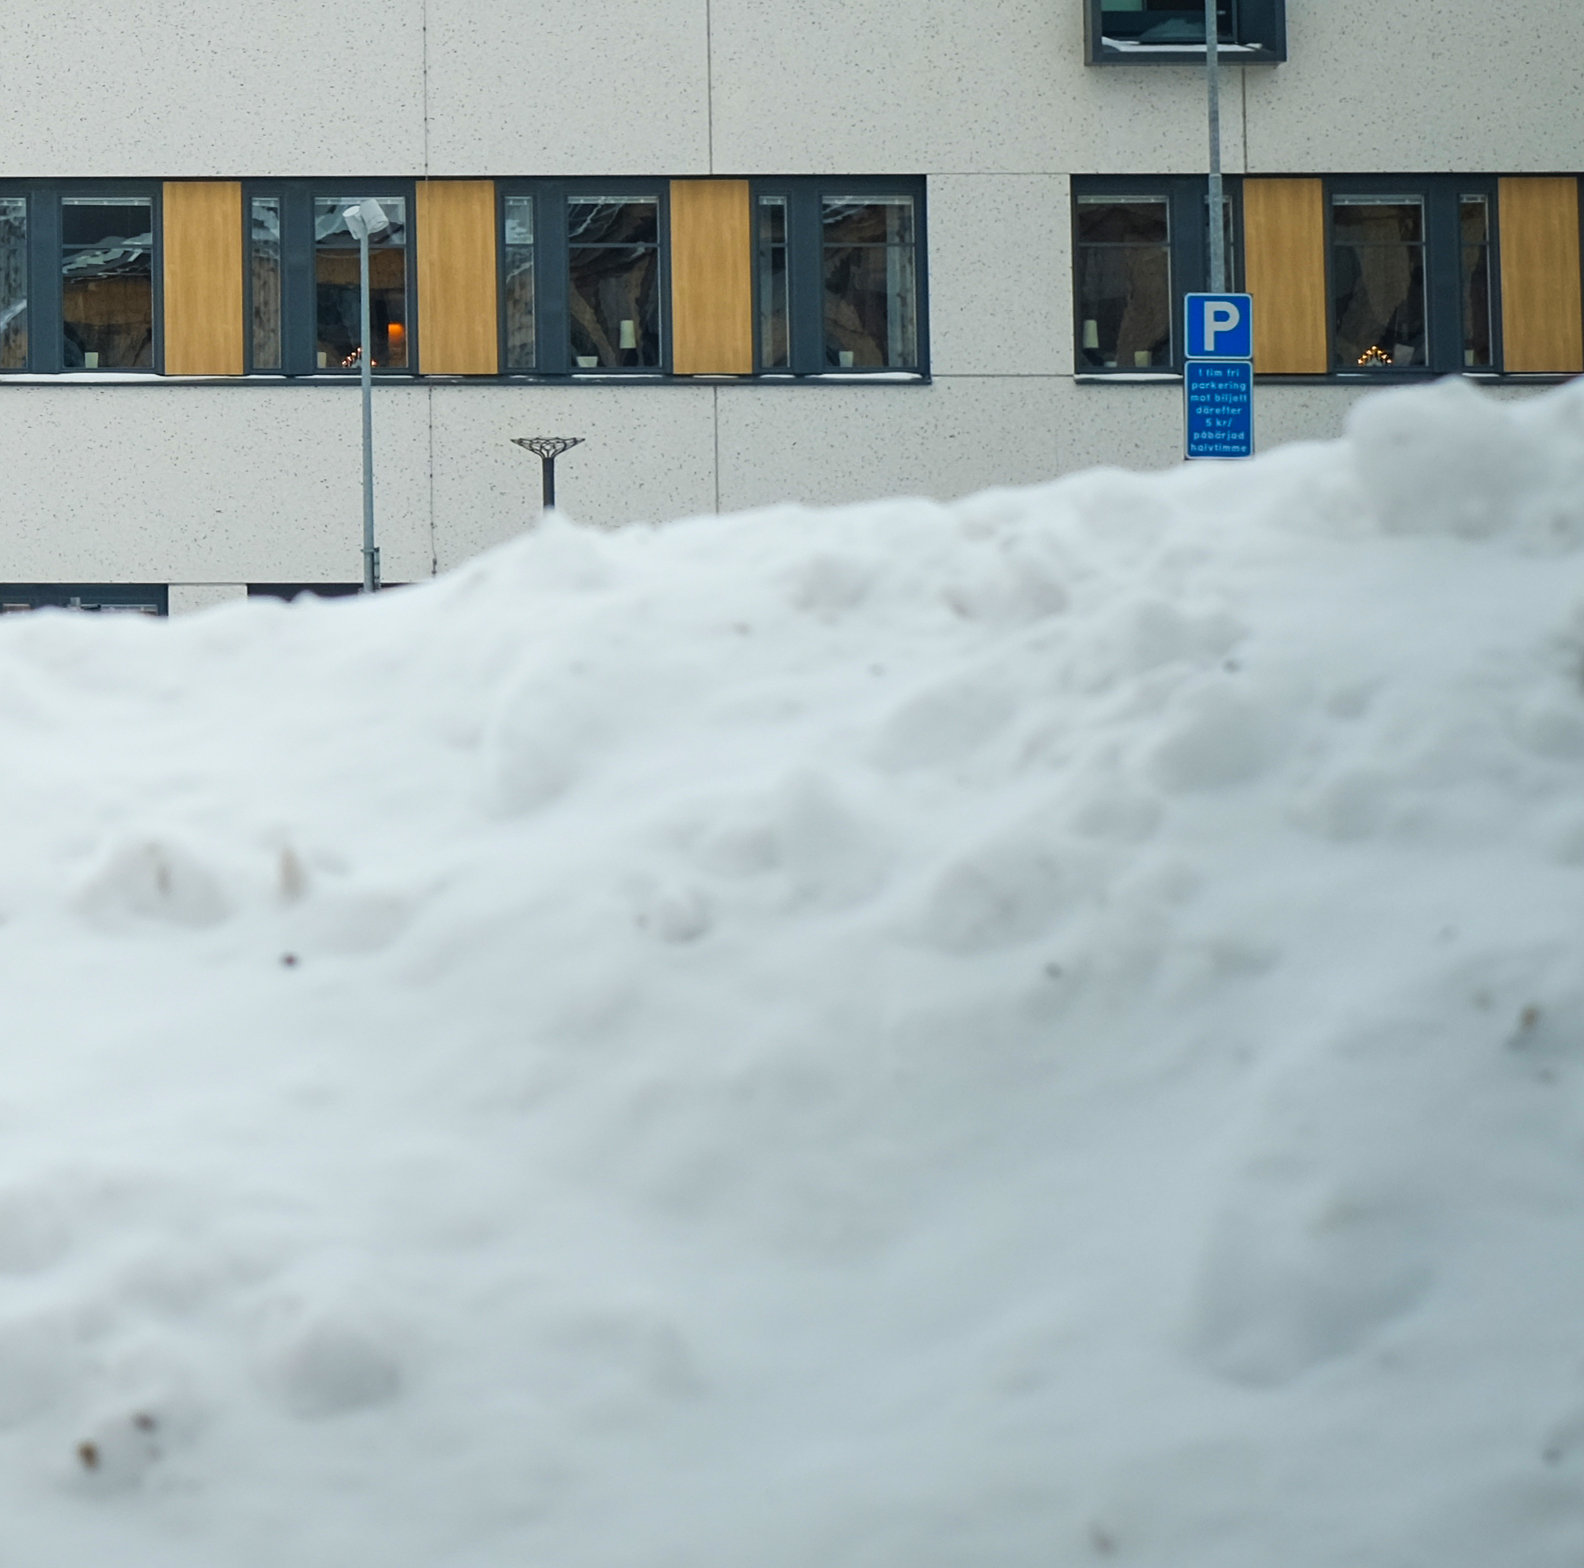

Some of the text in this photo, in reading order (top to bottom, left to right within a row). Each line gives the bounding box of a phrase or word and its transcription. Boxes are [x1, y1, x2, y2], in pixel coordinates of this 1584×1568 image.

[1204, 301, 1240, 351] P
[1206, 368, 1223, 377] tim
[1227, 368, 1240, 377] fri
[1191, 381, 1247, 391] parkering
[1190, 393, 1247, 404] mot biljett
[1195, 405, 1243, 415] därefter
[1193, 431, 1245, 441] påbörjad
[1190, 443, 1247, 452] halvtimme
